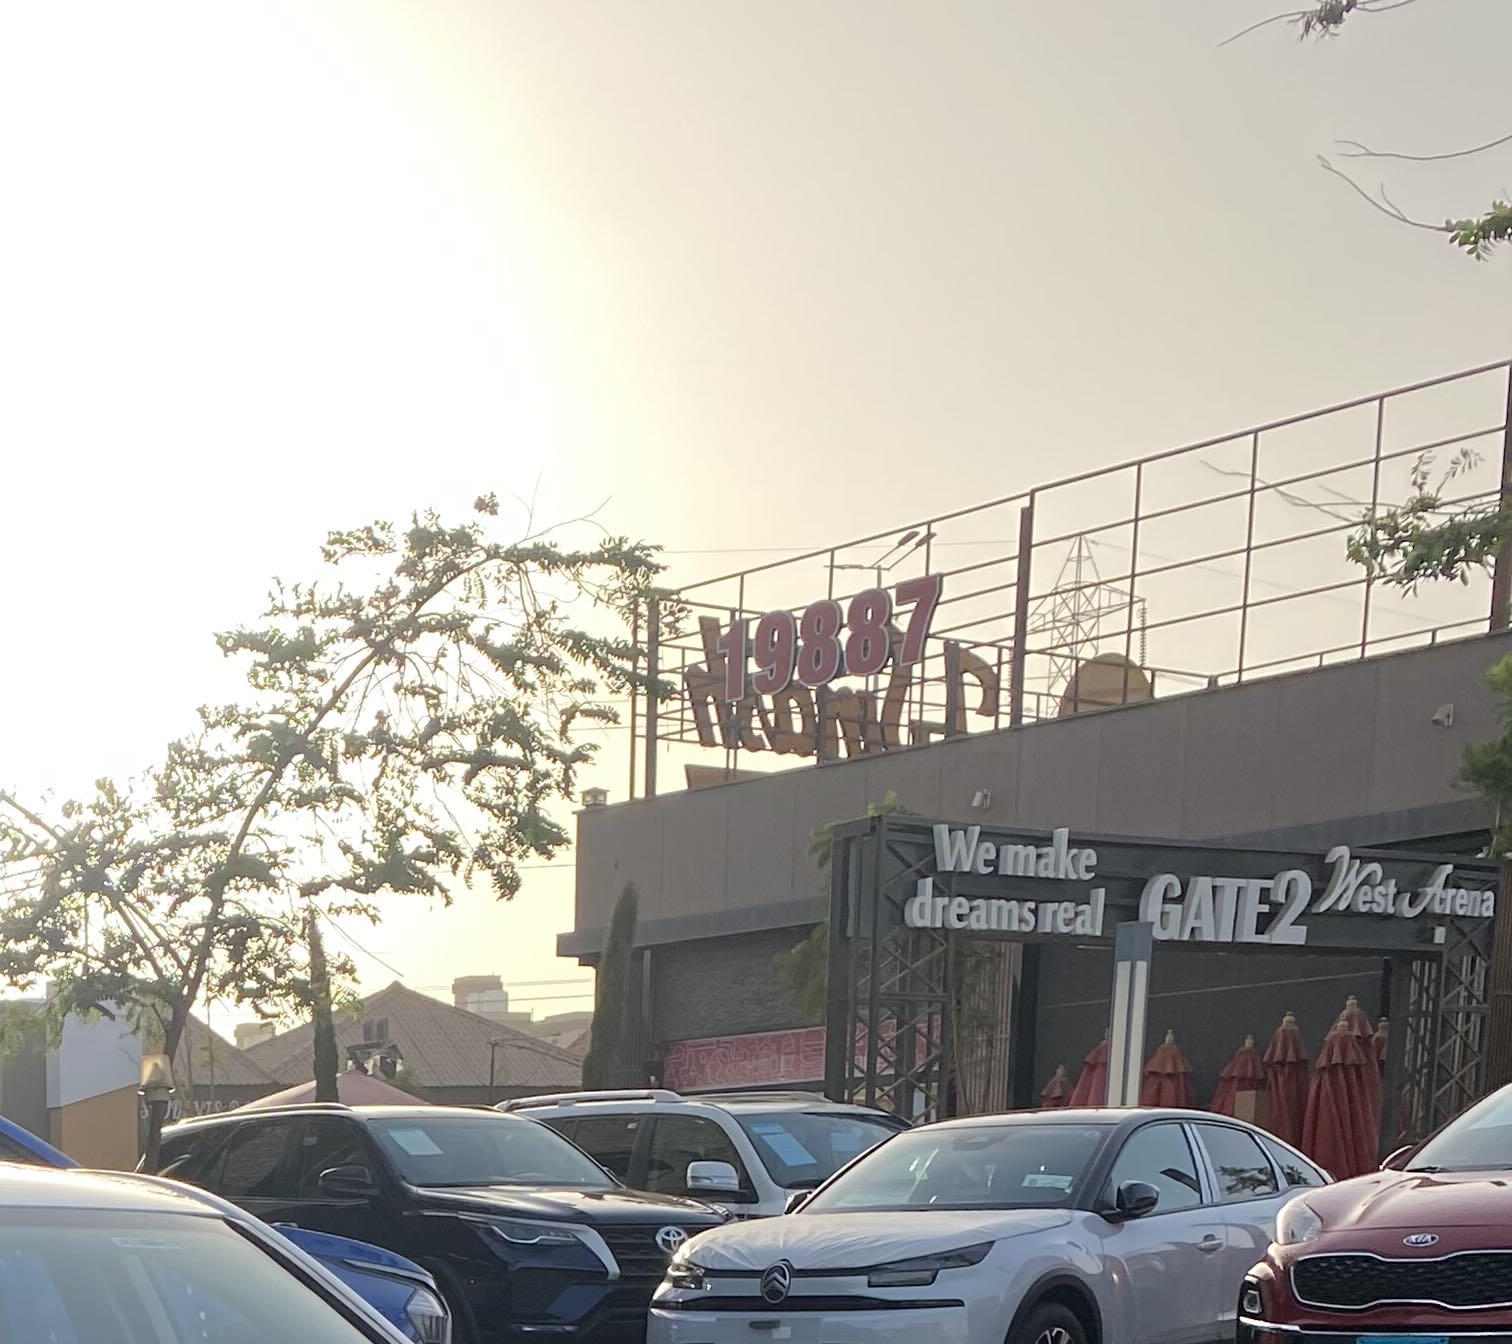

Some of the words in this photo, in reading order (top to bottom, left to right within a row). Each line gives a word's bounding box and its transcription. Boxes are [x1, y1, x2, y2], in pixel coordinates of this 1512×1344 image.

[717, 573, 944, 702] 19887
[933, 824, 996, 874] We
[998, 827, 1097, 880] make
[1311, 845, 1396, 915] West
[1395, 864, 1495, 919] Arena
[904, 877, 1036, 933] dreams
[1038, 887, 1106, 936] real
